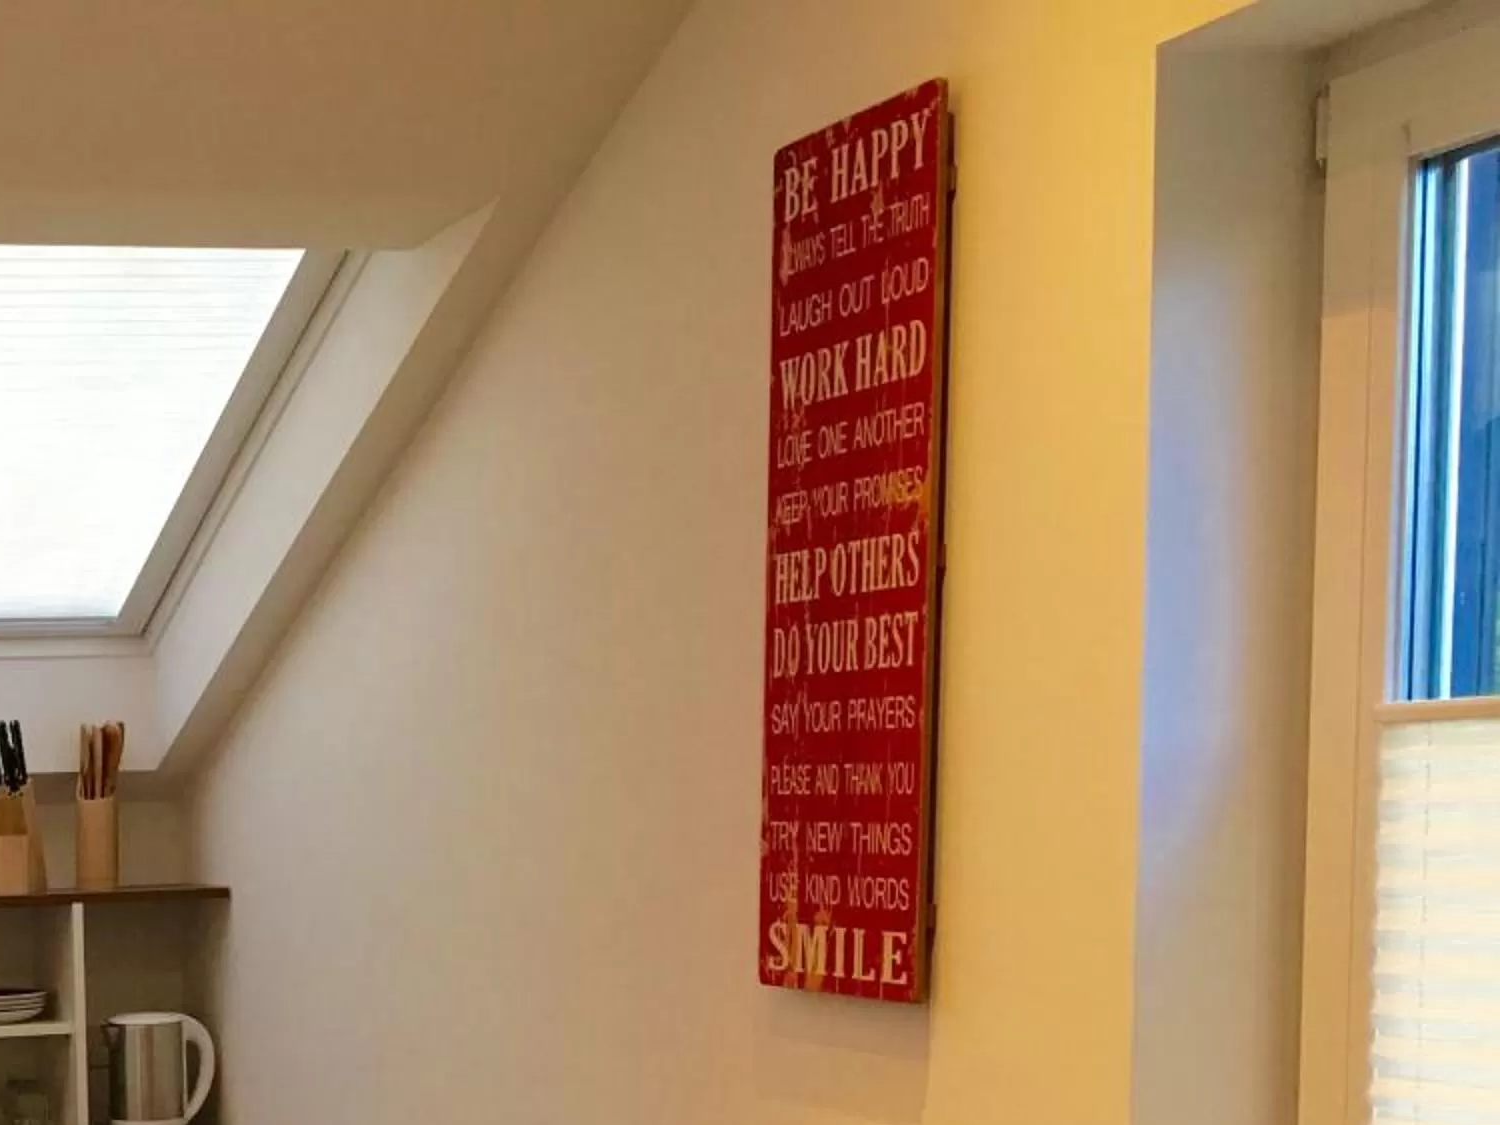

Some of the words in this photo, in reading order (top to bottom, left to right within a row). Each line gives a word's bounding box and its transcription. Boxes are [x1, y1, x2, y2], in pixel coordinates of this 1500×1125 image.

[784, 156, 818, 223] BE
[830, 107, 931, 204] HAPPY
[830, 221, 857, 259] TELL
[861, 209, 884, 249] THE
[889, 191, 931, 238] TRUTH
[779, 289, 832, 337] LAUGH
[839, 274, 875, 317] OUT
[881, 257, 929, 304] LOUD
[780, 340, 850, 410] WORK
[855, 319, 927, 392] HARD
[777, 430, 812, 469] LOVE
[818, 421, 848, 460] ONE
[852, 402, 925, 449] ANOTHER
[812, 481, 849, 518] YOUR
[853, 465, 924, 513] PROMISES
[775, 547, 827, 605] HELP
[830, 529, 921, 597] OTHERS
[773, 624, 799, 679] DO
[806, 619, 859, 675] YOUR
[864, 611, 918, 670] BEST
[771, 701, 799, 735] SAY
[804, 700, 841, 732] YOUR
[848, 695, 916, 731] PRAYERS
[771, 764, 812, 795] PLEASE
[815, 764, 839, 795] AND
[844, 763, 883, 795] THANK
[887, 762, 915, 796] YOU
[770, 821, 798, 850] TRY
[806, 822, 843, 853] NEW
[851, 823, 912, 856] THINGS
[769, 872, 798, 903] USE
[805, 874, 841, 905] KIND
[848, 876, 910, 911] WORDS
[768, 920, 907, 985] SMILE
